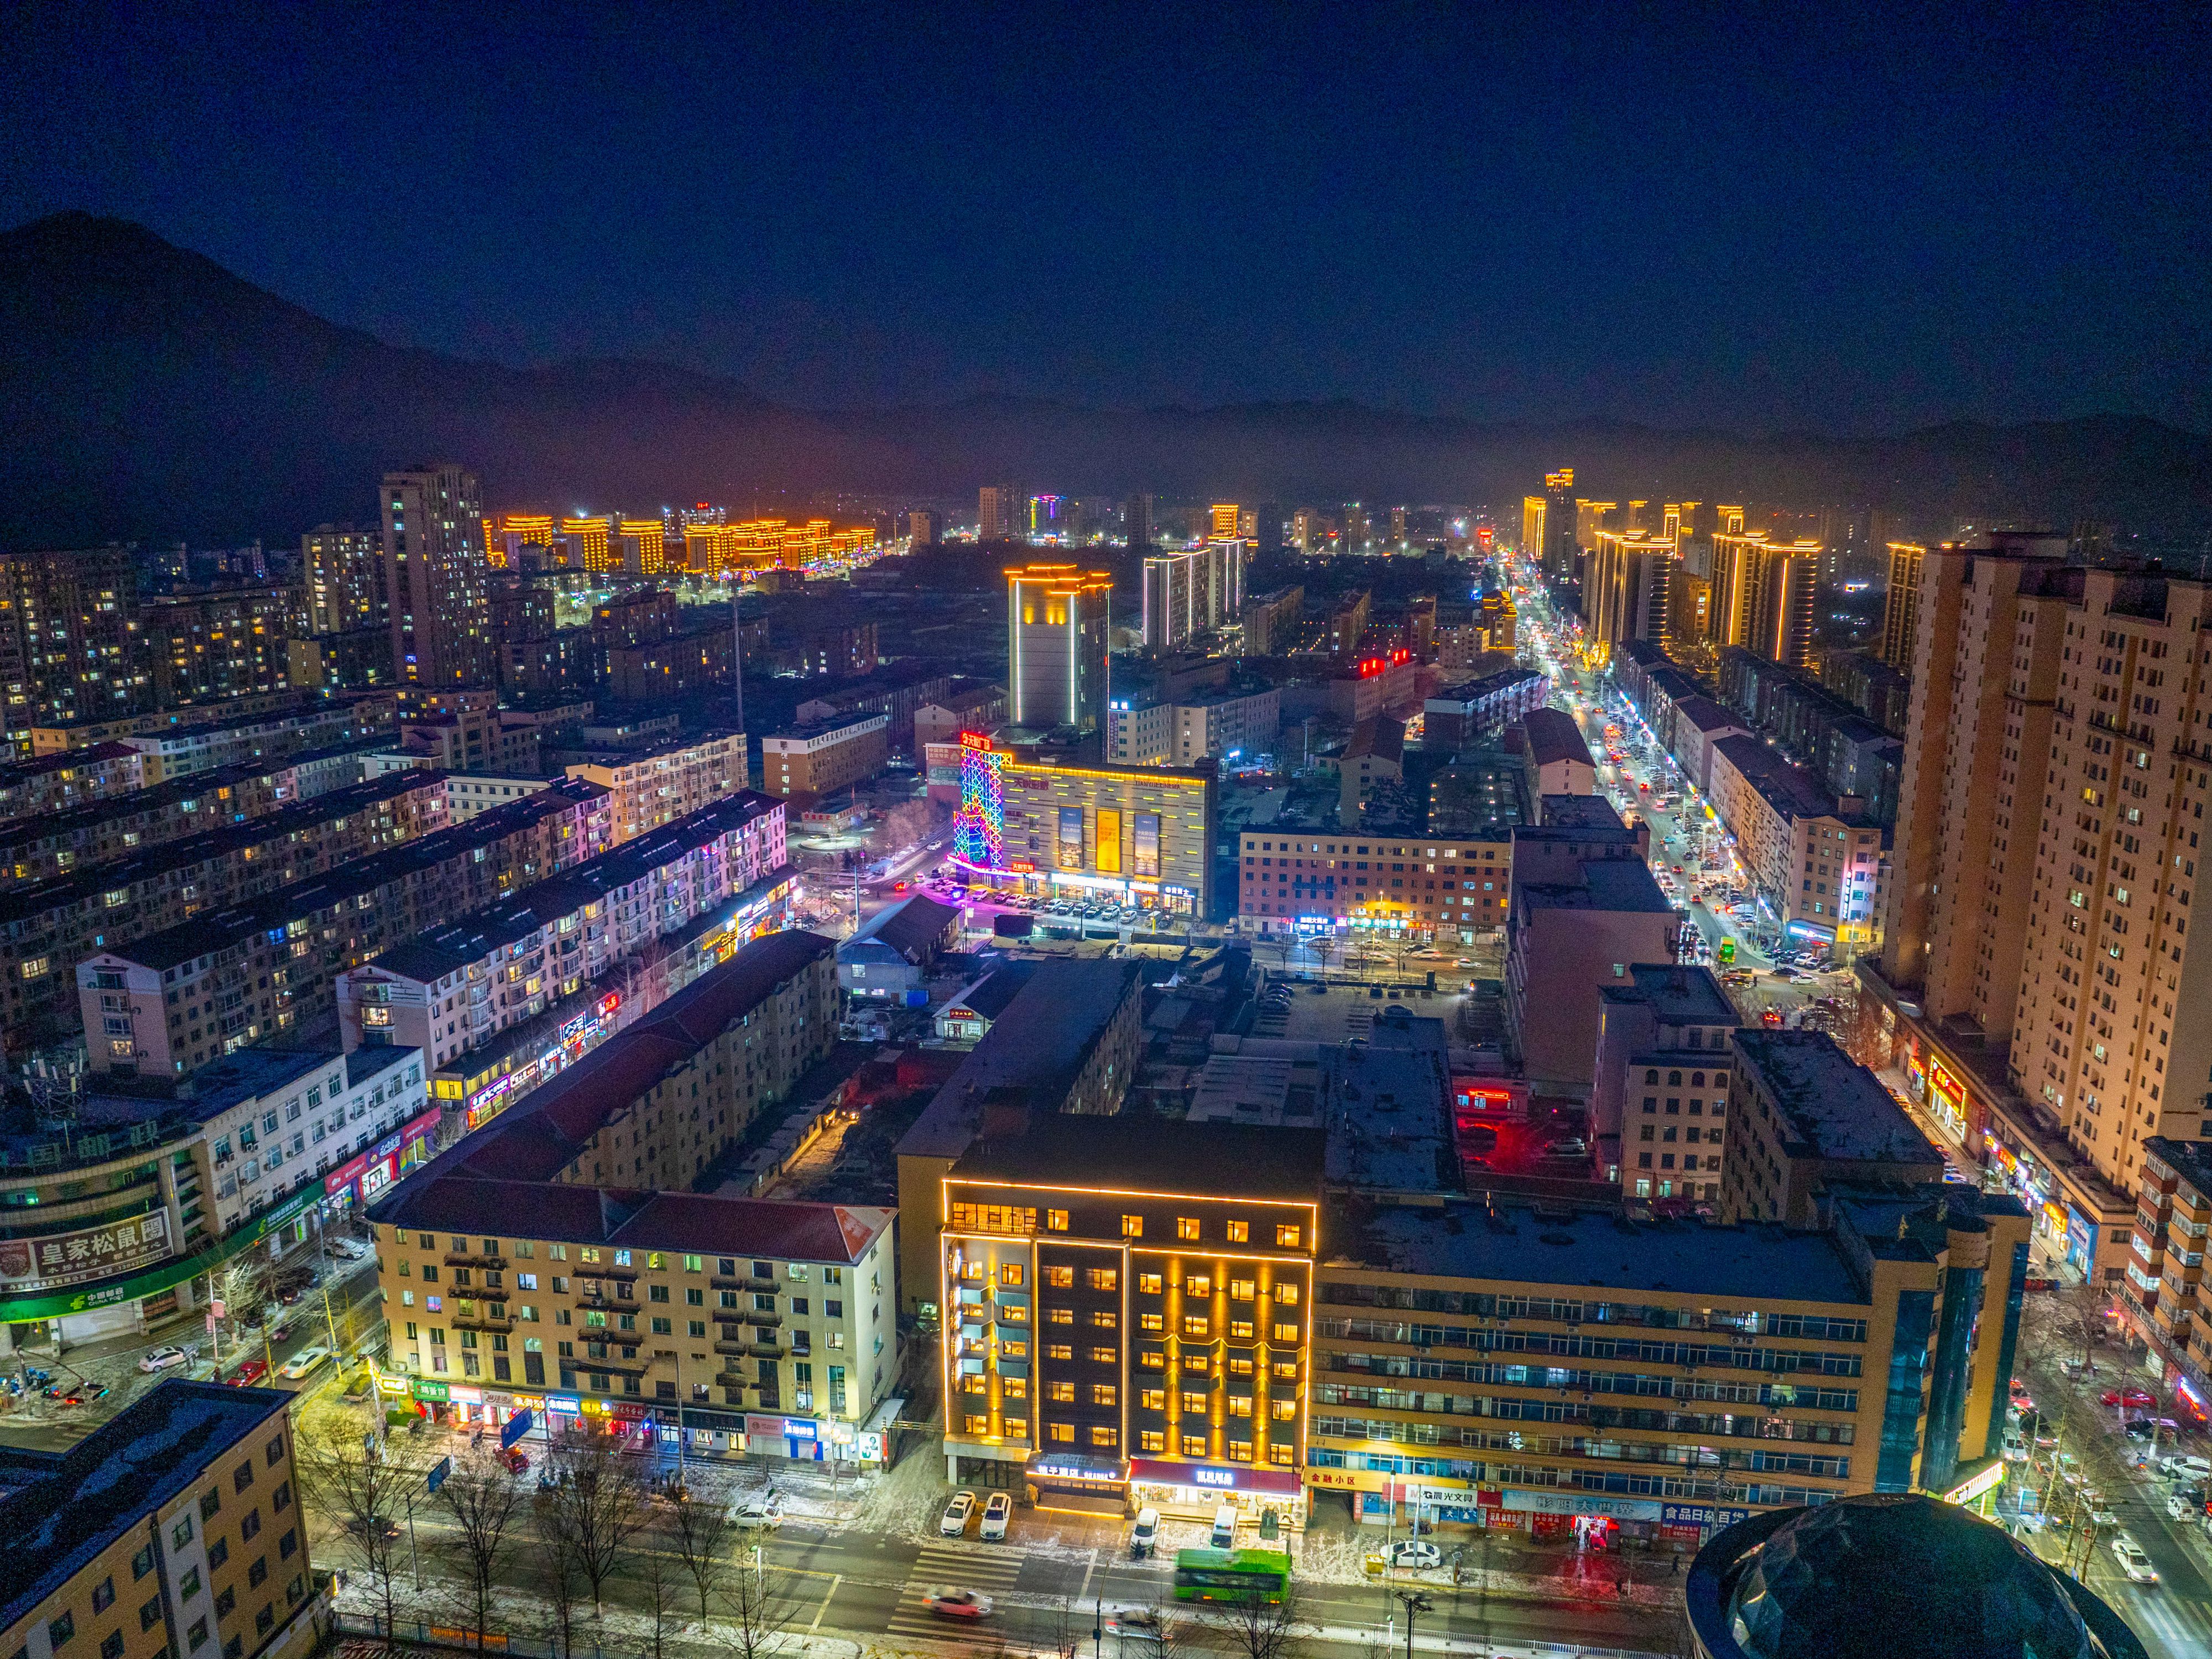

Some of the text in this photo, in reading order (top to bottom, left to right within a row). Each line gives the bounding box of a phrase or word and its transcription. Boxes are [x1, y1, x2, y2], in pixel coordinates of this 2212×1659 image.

[42, 1226, 139, 1265] 皇家松鼠
[88, 1294, 124, 1306] CHINA POST
[420, 1385, 446, 1397] 鸡蛋饼
[1311, 1473, 1355, 1485] 金融小区
[1433, 1491, 1473, 1503] 晨光文具
[1490, 1512, 1500, 1521] 玩具
[1666, 1506, 1745, 1524] 食品日杂百货
